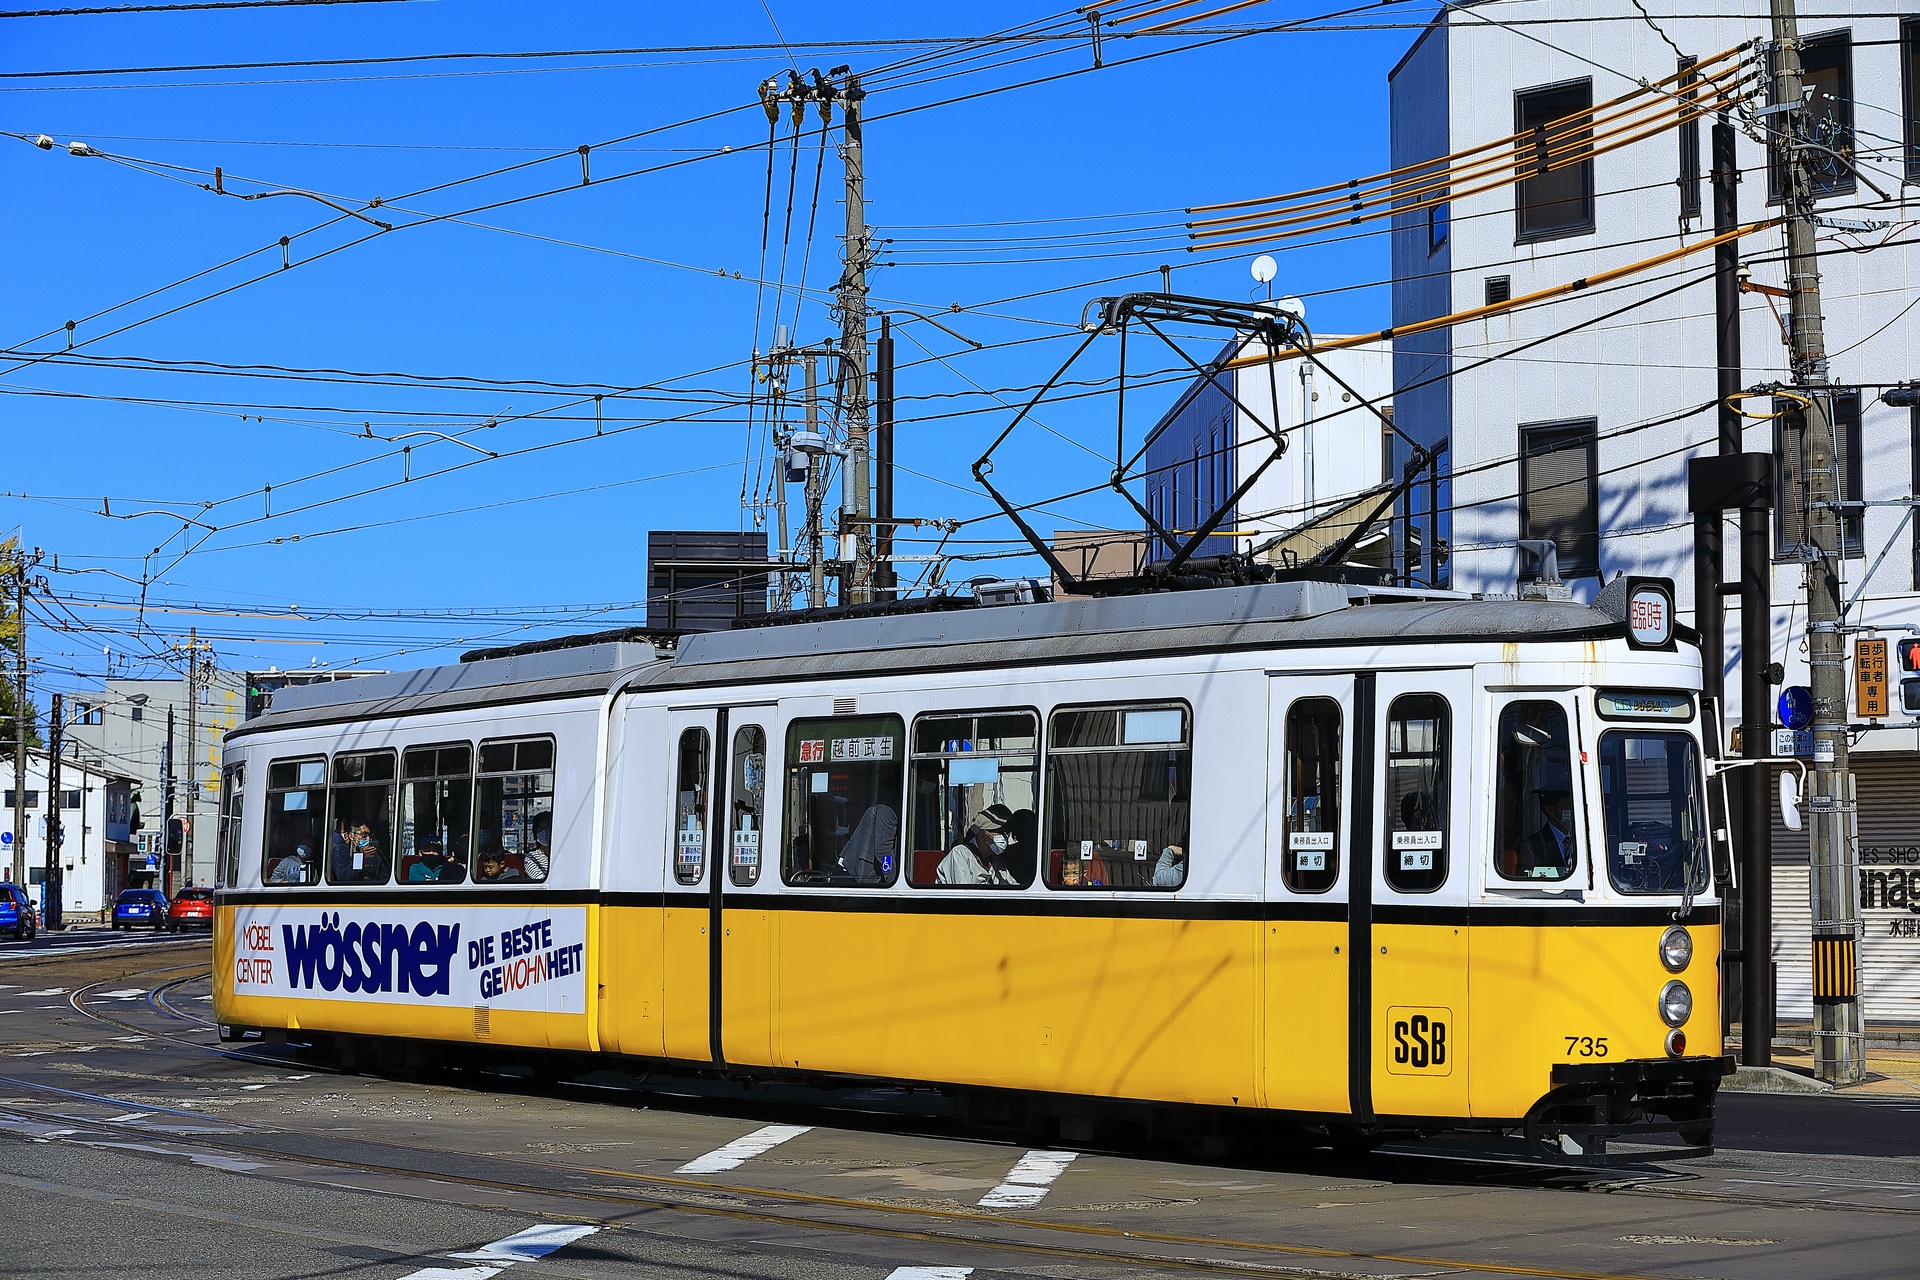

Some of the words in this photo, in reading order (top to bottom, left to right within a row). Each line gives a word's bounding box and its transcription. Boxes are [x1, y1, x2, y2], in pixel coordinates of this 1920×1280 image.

[1632, 600, 1662, 631] 臨時
[1860, 644, 1871, 682] 自転車
[1872, 643, 1884, 682] 歩行者
[1867, 686, 1878, 712] 専用
[801, 741, 824, 762] 急行
[832, 738, 892, 758] 越前武生
[1293, 836, 1329, 845] 乗務員出入口
[1396, 836, 1437, 845] 乗務員出入口
[1299, 855, 1322, 866] 締切
[1403, 855, 1430, 866] 締切
[242, 920, 274, 951] MÖBEL
[1889, 919, 1920, 938] 水曜
[281, 911, 460, 996] wössner
[468, 935, 495, 970] DIE
[501, 918, 552, 960] BESTE
[236, 958, 274, 984] CENTER
[480, 943, 583, 999] GEWOHNHEIT
[1394, 1015, 1446, 1068] SSB
[1564, 1036, 1609, 1057] 735
